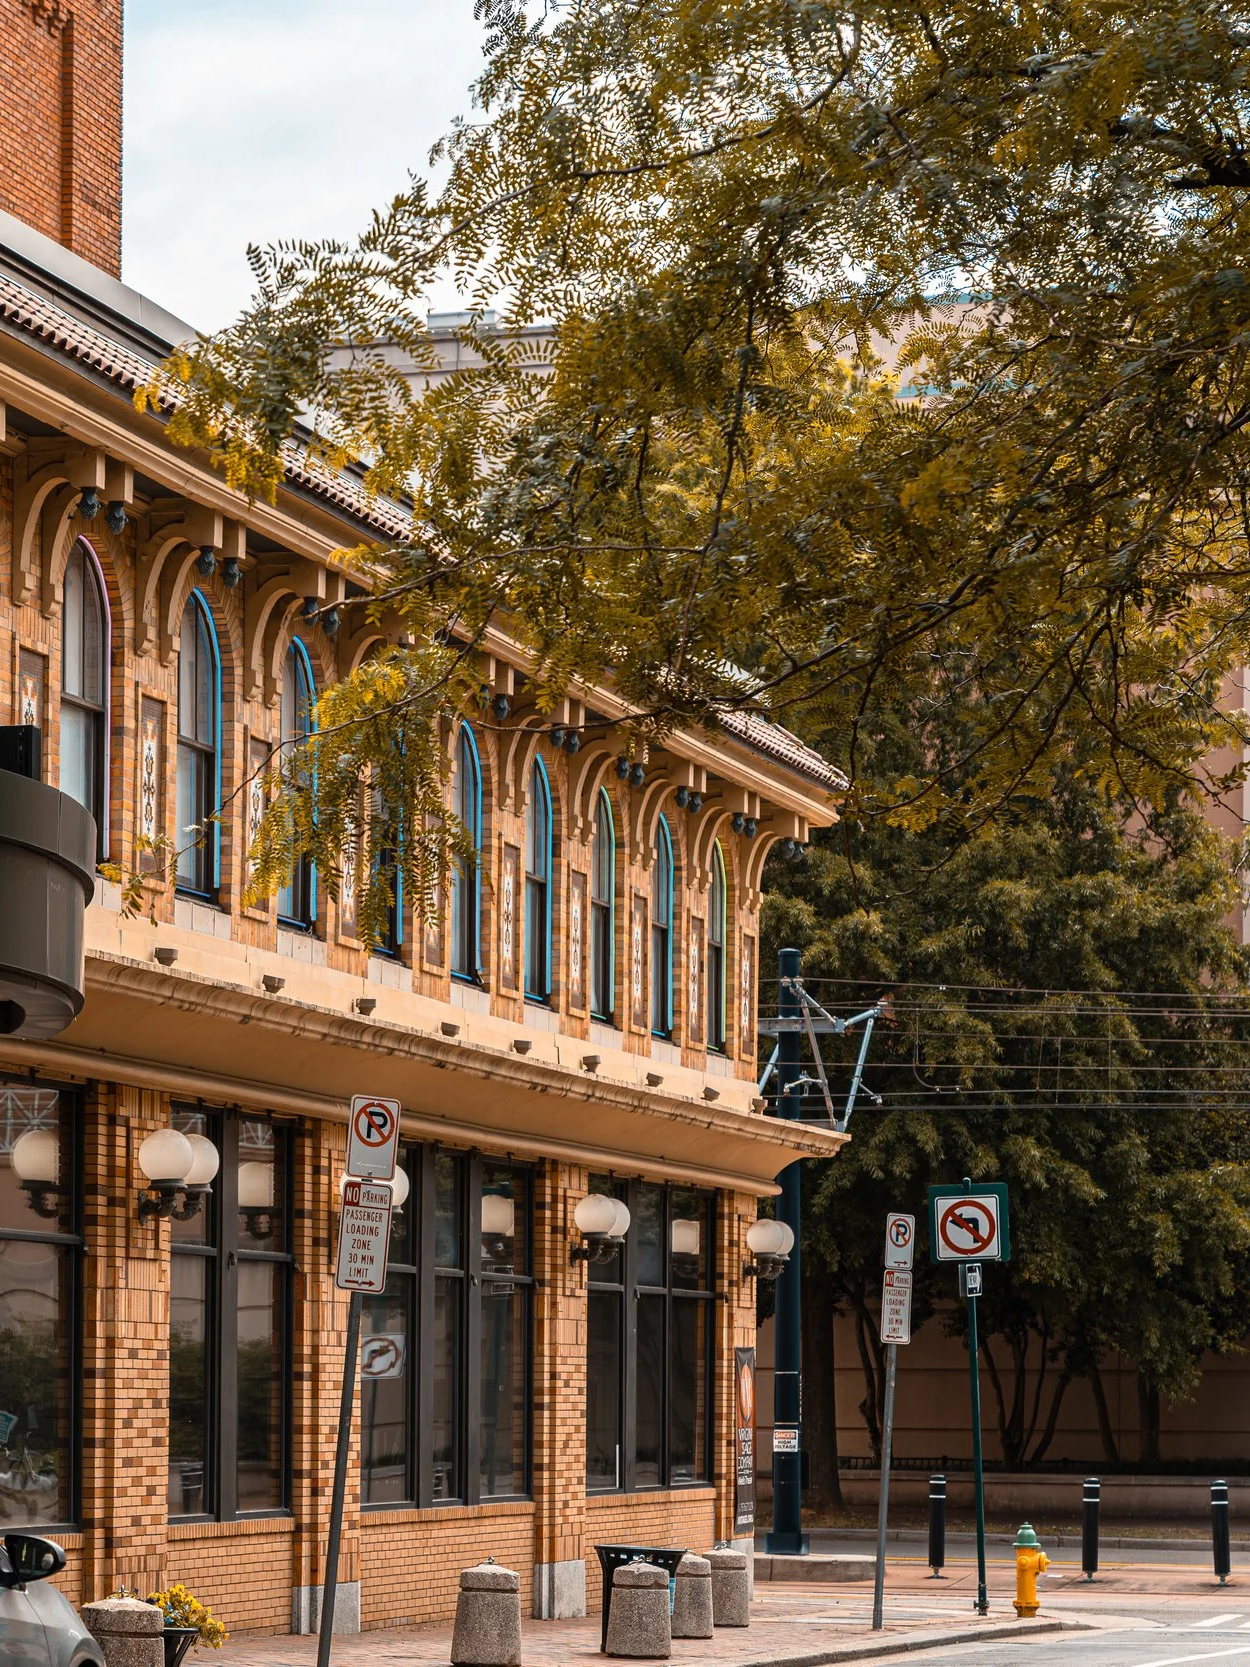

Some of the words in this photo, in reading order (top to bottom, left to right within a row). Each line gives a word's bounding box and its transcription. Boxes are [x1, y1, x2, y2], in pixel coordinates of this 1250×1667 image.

[345, 1186, 359, 1203] NO
[362, 1191, 388, 1205] PARKING
[345, 1208, 383, 1223] PASSENGER
[345, 1223, 379, 1237] LOADING
[351, 1238, 371, 1250] ZONE
[348, 1252, 358, 1264] 30
[360, 1254, 375, 1265] MIN
[349, 1266, 369, 1278] LIMIT
[886, 1273, 893, 1285] NO
[895, 1276, 910, 1286] PARKING
[886, 1288, 907, 1297] PASSENGER
[886, 1298, 905, 1307] LOADING
[889, 1308, 901, 1316] ZONE
[888, 1327, 900, 1335] LIMIT
